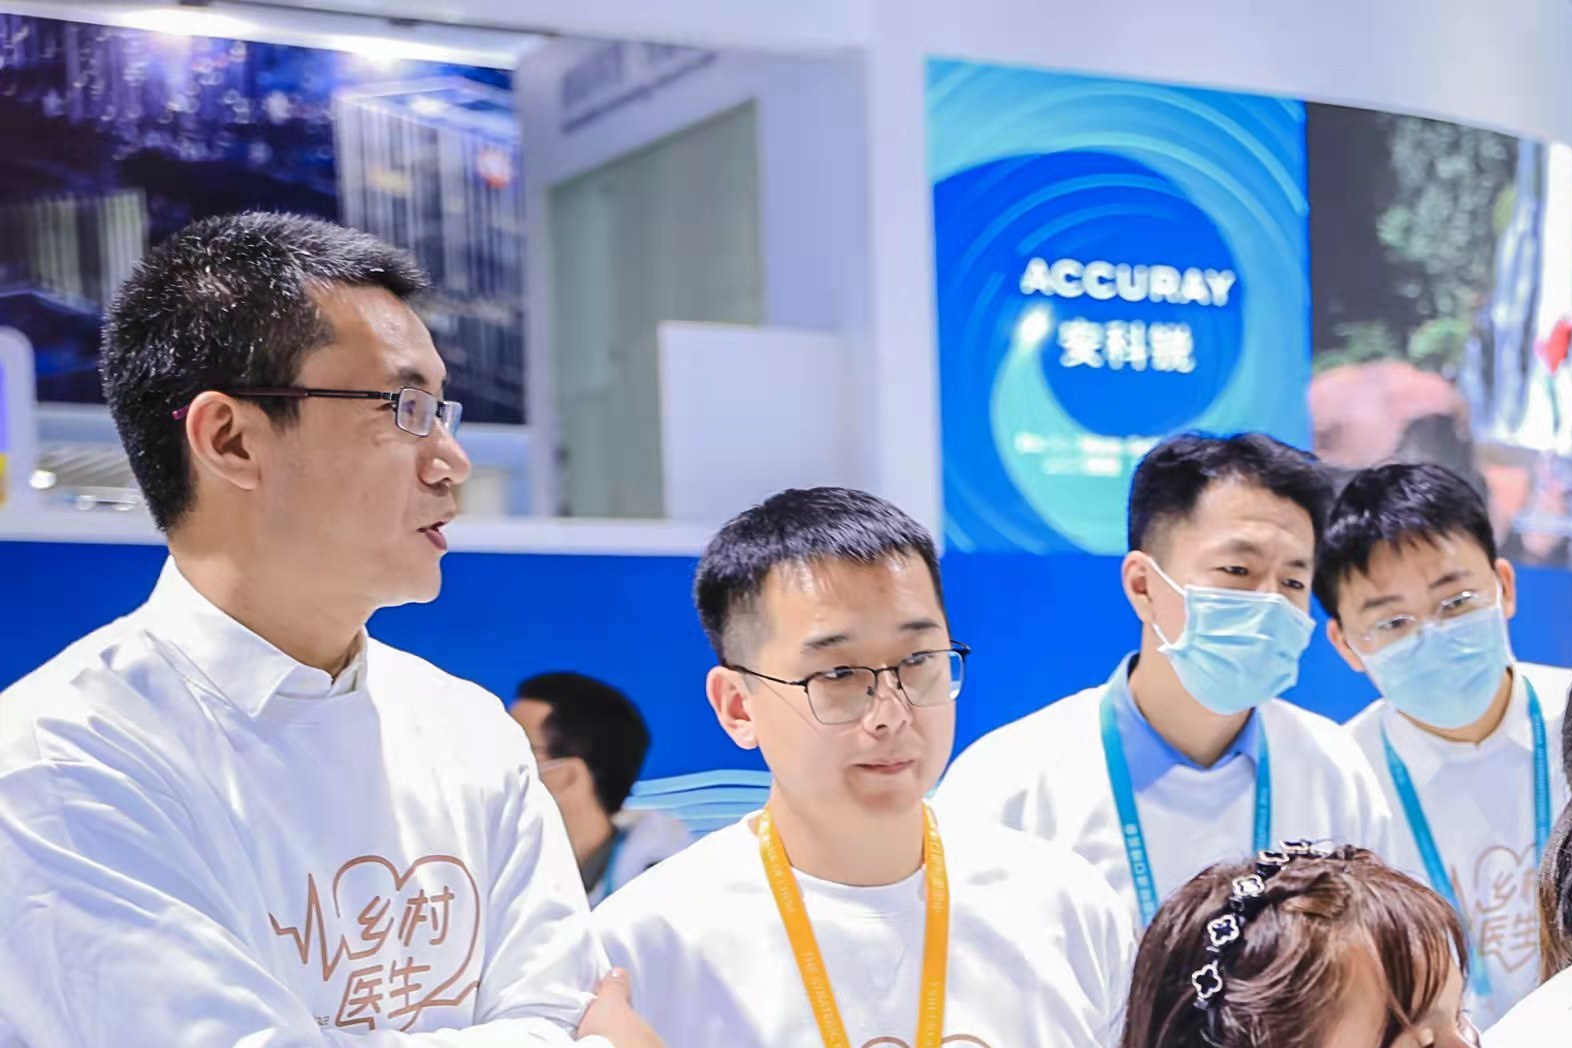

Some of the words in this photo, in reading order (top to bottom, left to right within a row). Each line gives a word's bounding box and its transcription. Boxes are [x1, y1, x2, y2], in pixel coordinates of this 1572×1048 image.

[1019, 256, 1237, 307] ACCURAY
[350, 884, 455, 960] 乡村
[335, 956, 432, 1031] 医生
